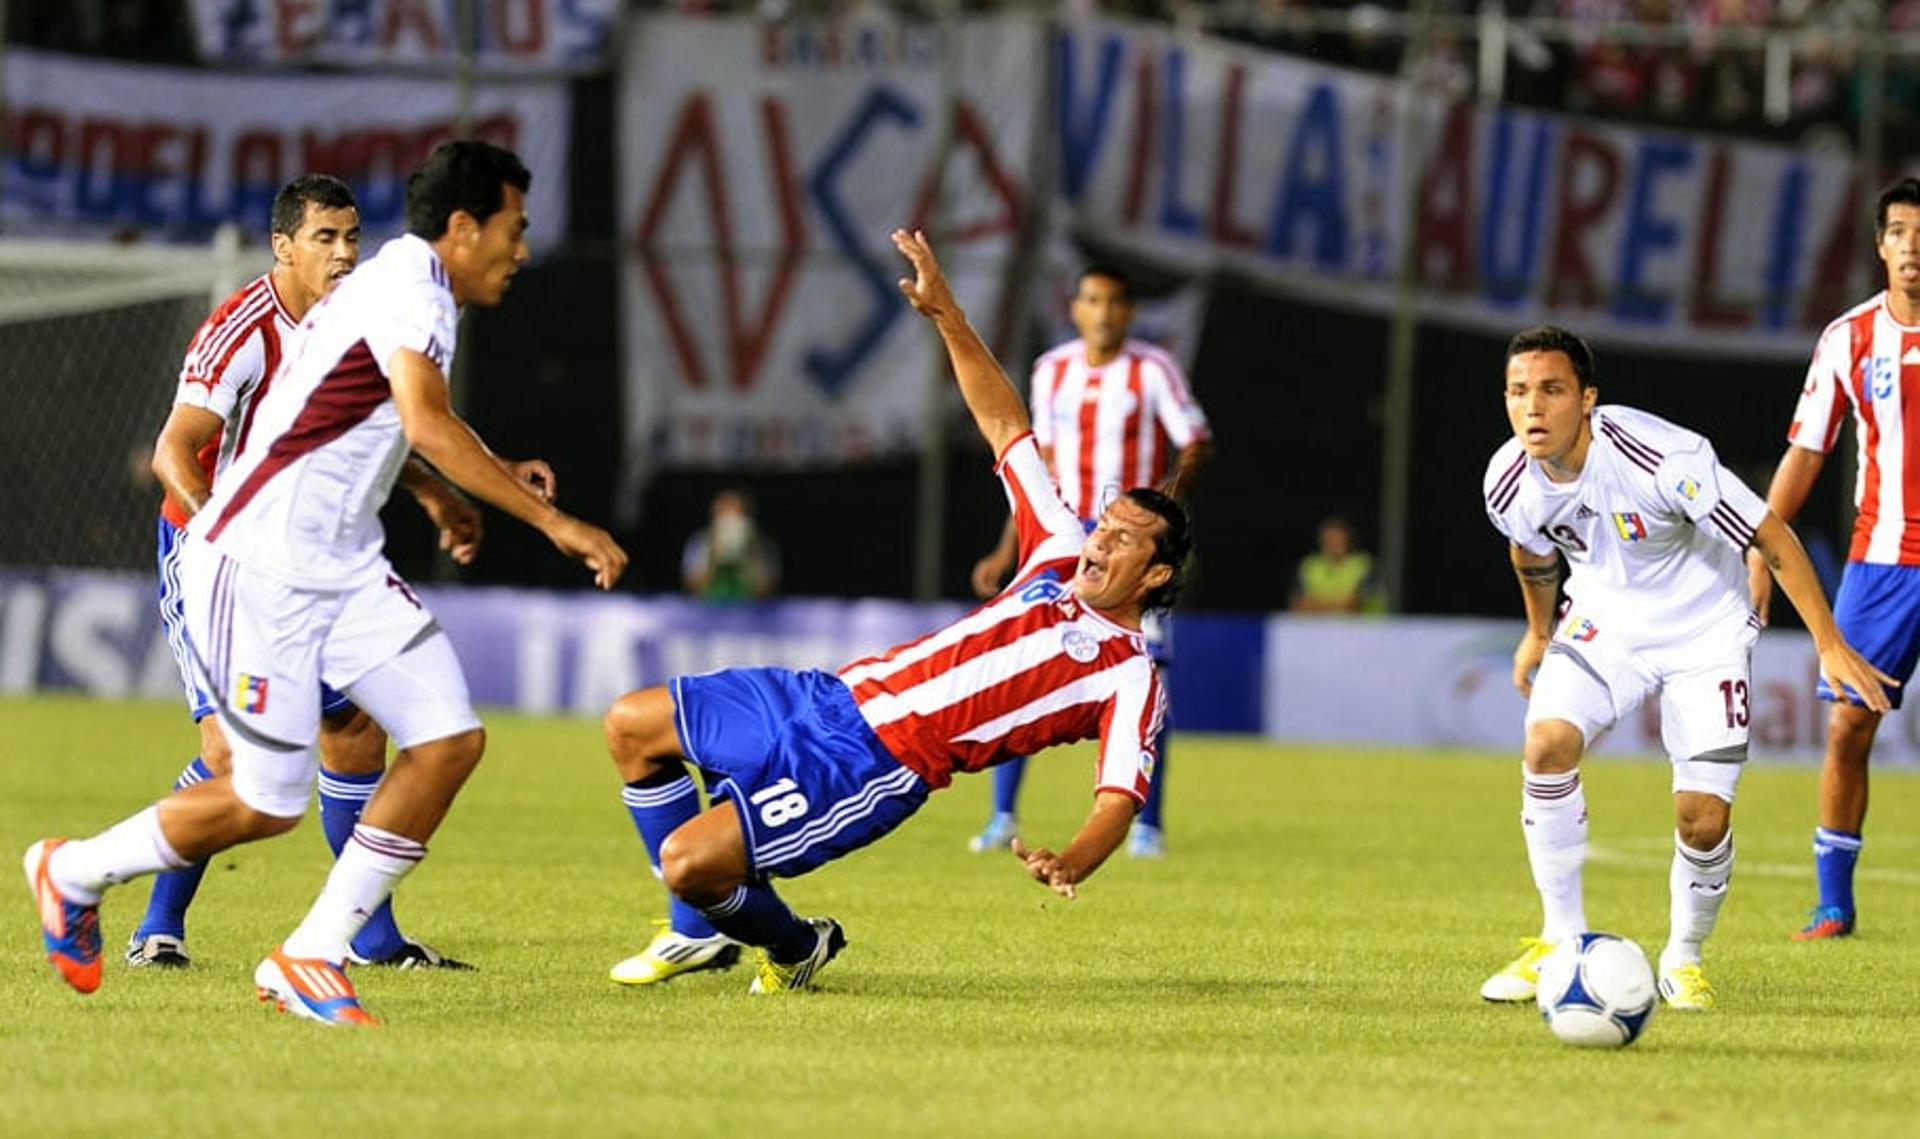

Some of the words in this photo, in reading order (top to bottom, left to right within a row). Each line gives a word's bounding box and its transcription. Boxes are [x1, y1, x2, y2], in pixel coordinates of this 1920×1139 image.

[1053, 28, 1346, 269] VILLA
[1718, 679, 1750, 728] 13
[750, 777, 808, 827] 18
